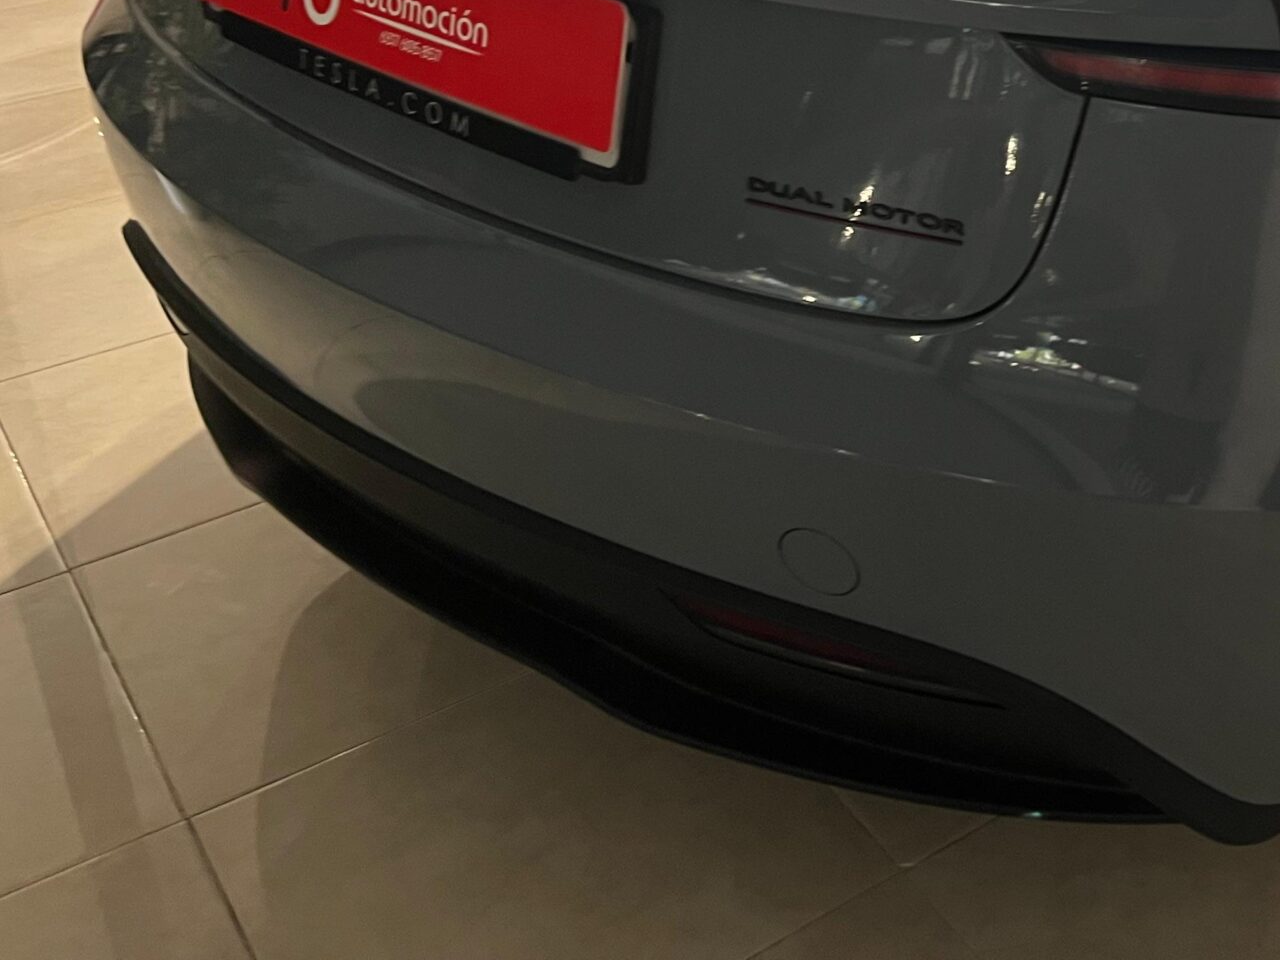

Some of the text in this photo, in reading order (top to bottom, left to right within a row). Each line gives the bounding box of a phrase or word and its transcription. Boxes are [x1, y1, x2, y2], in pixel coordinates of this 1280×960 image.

[299, 48, 471, 137] TESLA.COM
[747, 176, 965, 237] DUAL MOTOR
